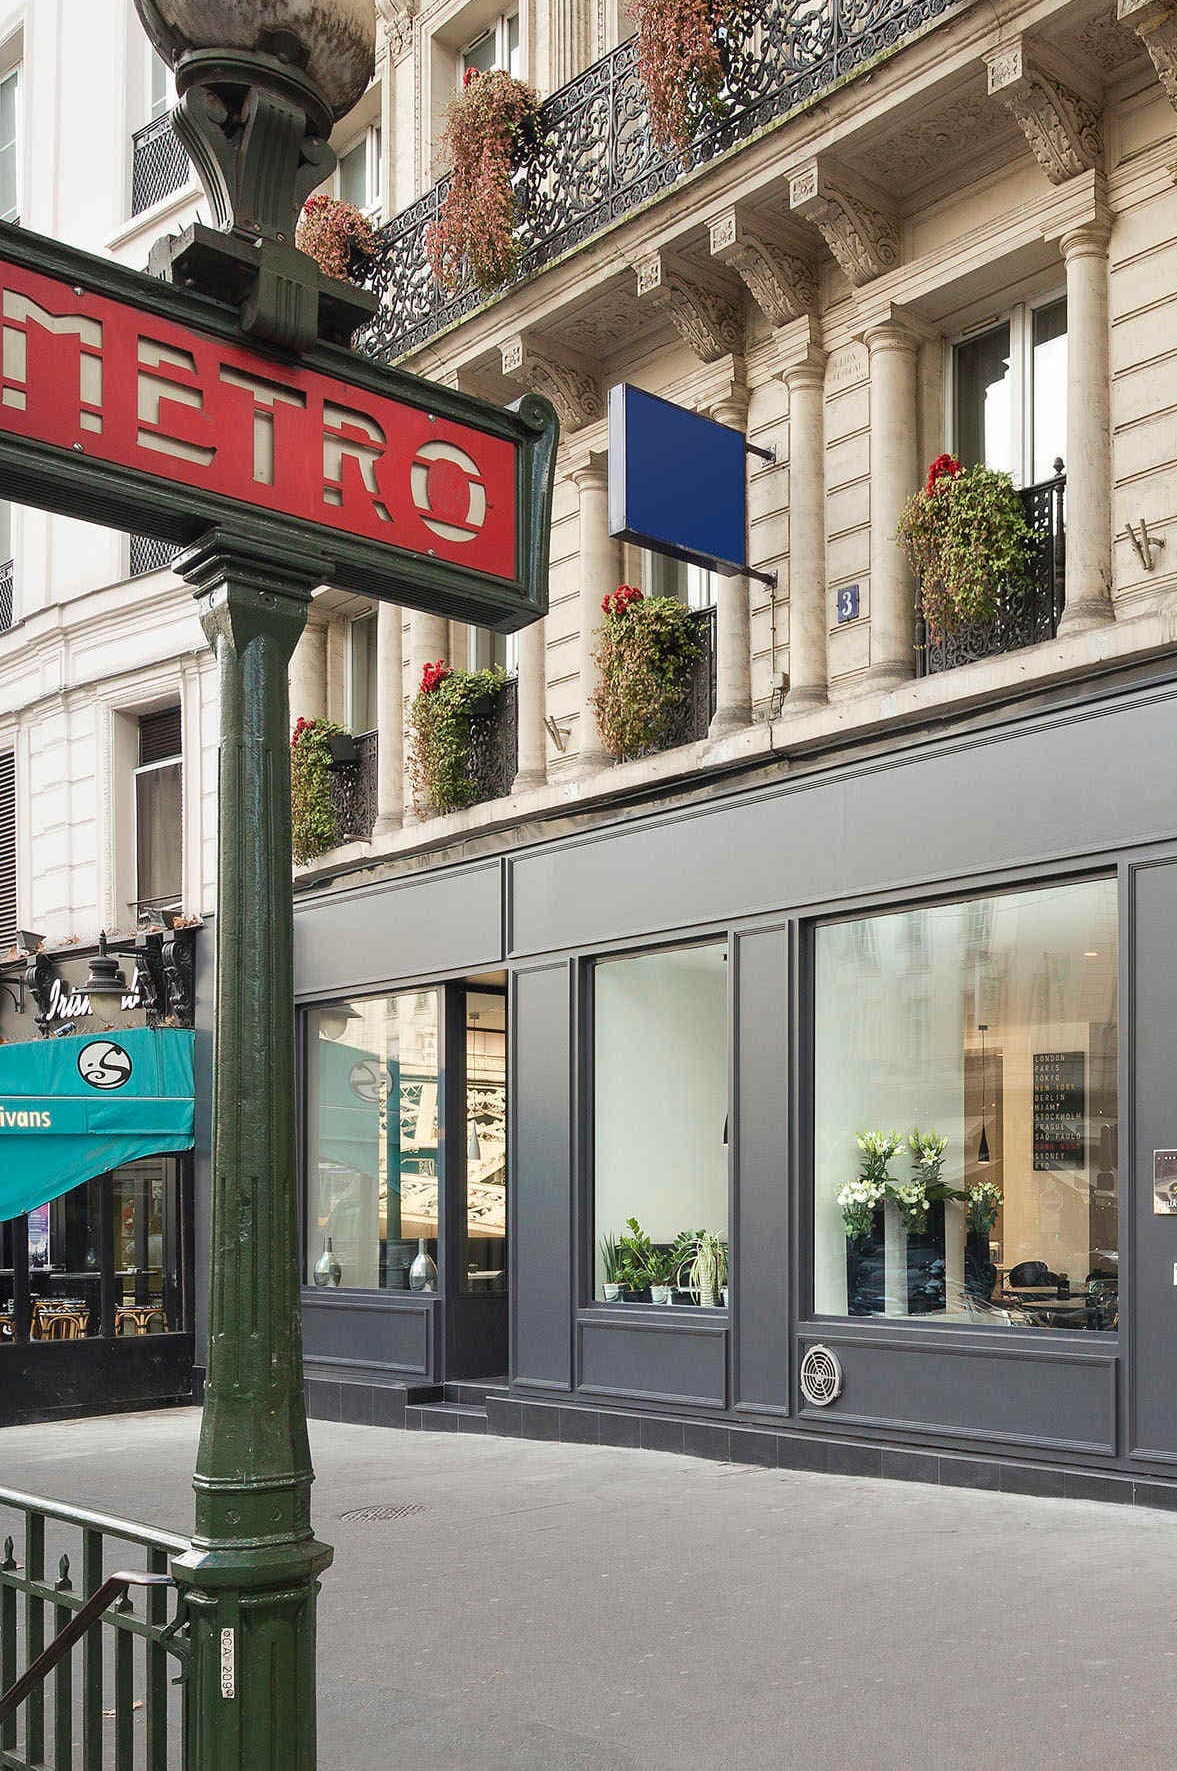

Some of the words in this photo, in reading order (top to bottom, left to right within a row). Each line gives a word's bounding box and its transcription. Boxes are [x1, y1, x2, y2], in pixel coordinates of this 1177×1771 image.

[2, 286, 488, 544] METRO
[841, 591, 853, 616] 3
[1034, 1054, 1065, 1062] LONDON
[1034, 1094, 1065, 1102] BERLIN
[1034, 1112, 1081, 1121] STOCKHOLM
[1034, 1123, 1065, 1131] PRAGUE
[1034, 1152, 1065, 1160] SYDNEY
[222, 1667, 233, 1689] 209
